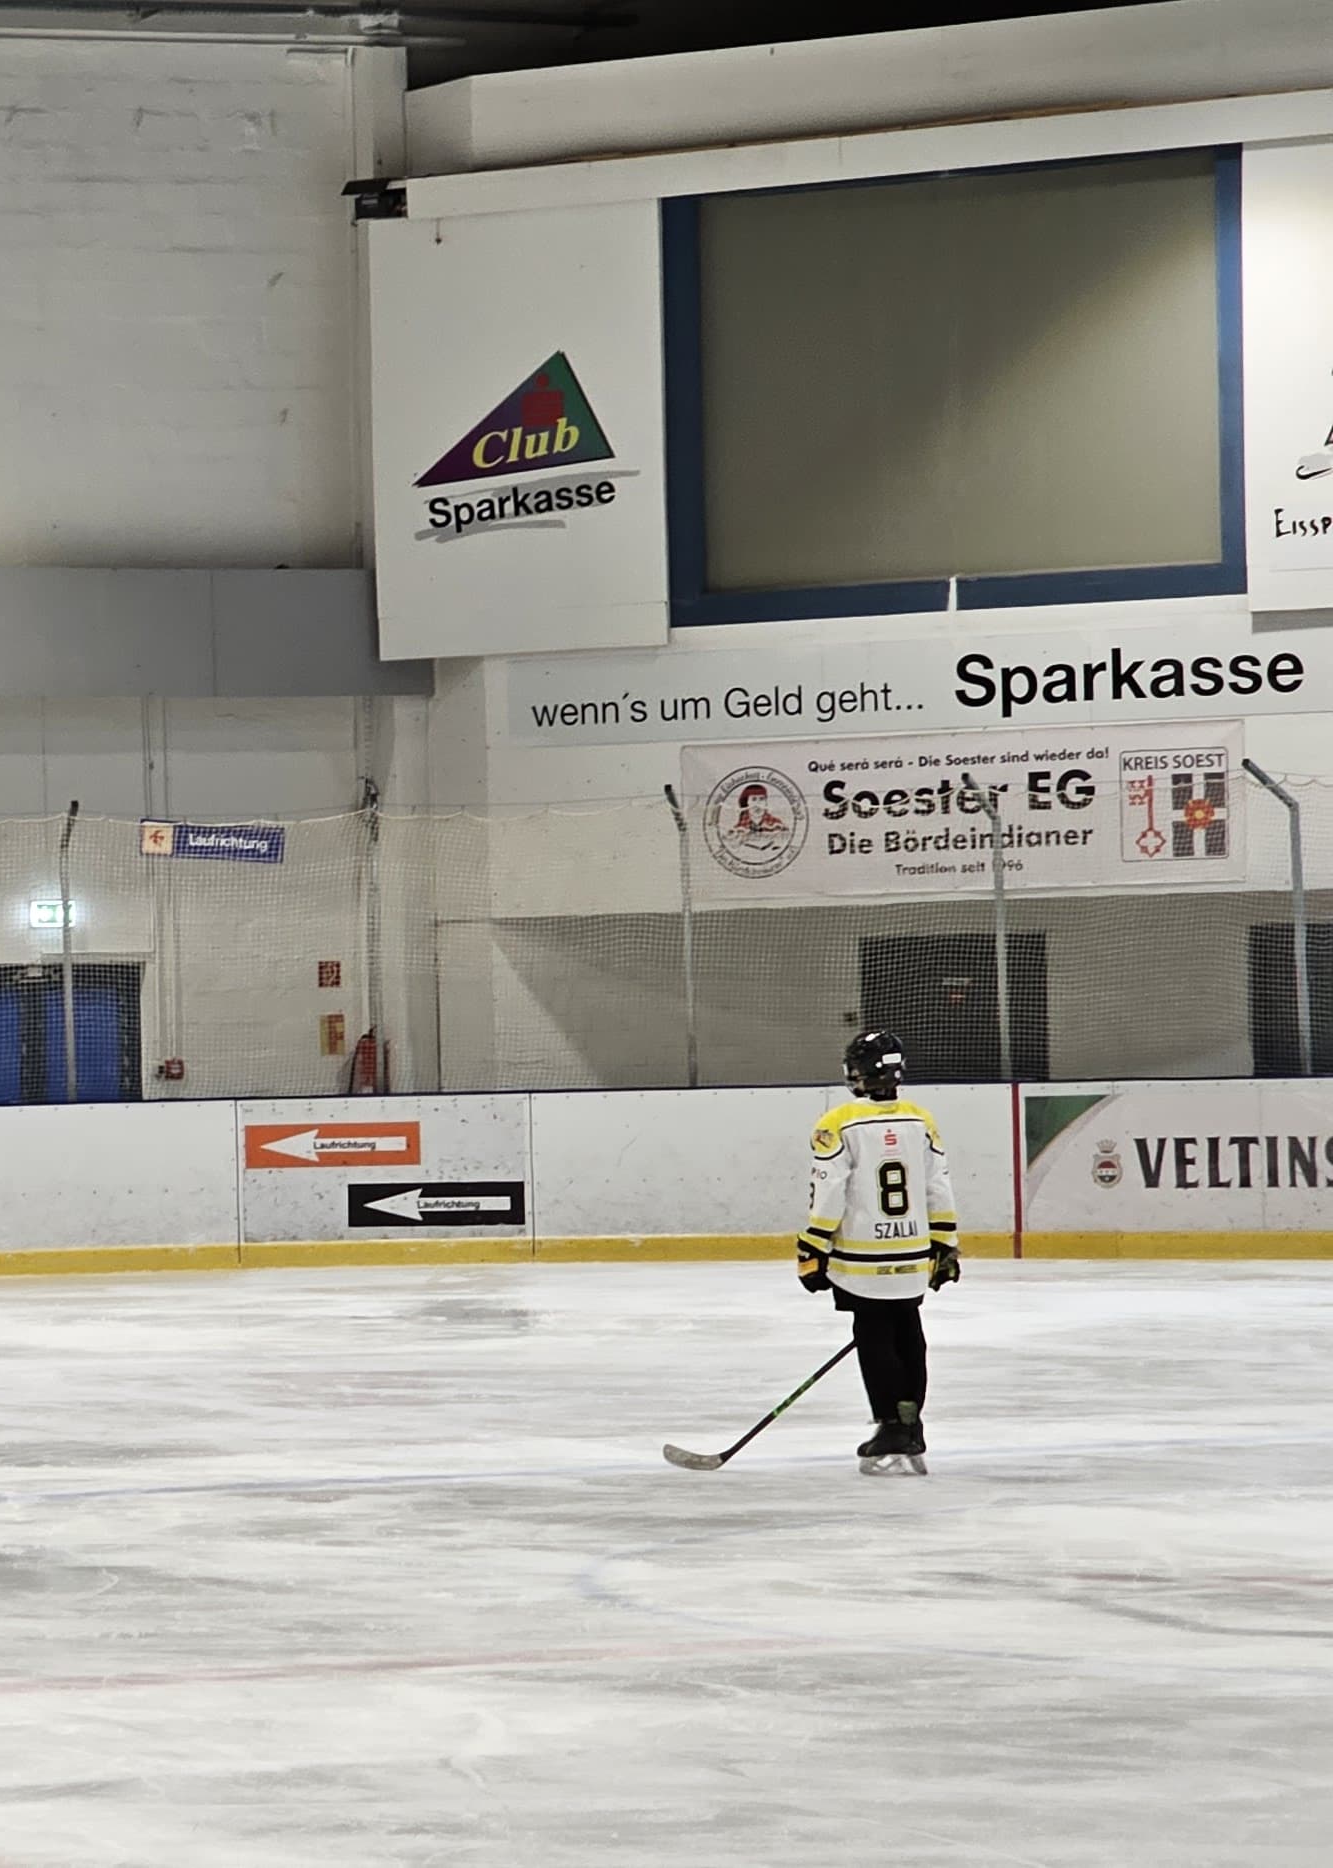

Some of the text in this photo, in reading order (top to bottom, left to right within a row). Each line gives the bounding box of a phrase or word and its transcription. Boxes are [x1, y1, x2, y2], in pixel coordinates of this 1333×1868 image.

[471, 416, 581, 469] Club
[427, 480, 617, 534] Sparkasse
[659, 694, 711, 723] um
[723, 684, 803, 719] Geld
[815, 681, 925, 723] geht...
[954, 647, 1305, 719] Sparkasse
[807, 759, 836, 774] Qué
[918, 753, 941, 768] Die
[945, 752, 997, 768] Soester
[999, 750, 1031, 764] sind
[1033, 748, 1083, 762] wieder
[1085, 746, 1111, 760] da!
[1122, 752, 1226, 772] KREIS SOEST
[822, 768, 1096, 820] Soester EG
[188, 833, 269, 854] Laufrichtung
[827, 824, 1094, 856] Die Bördeindianer
[895, 861, 957, 876] Tradition
[960, 860, 986, 874] seit
[312, 1140, 377, 1151] Laufrichtung
[877, 1159, 910, 1219] 8
[416, 1199, 481, 1210] Laufrichtung
[874, 1220, 918, 1240] SZALAI
